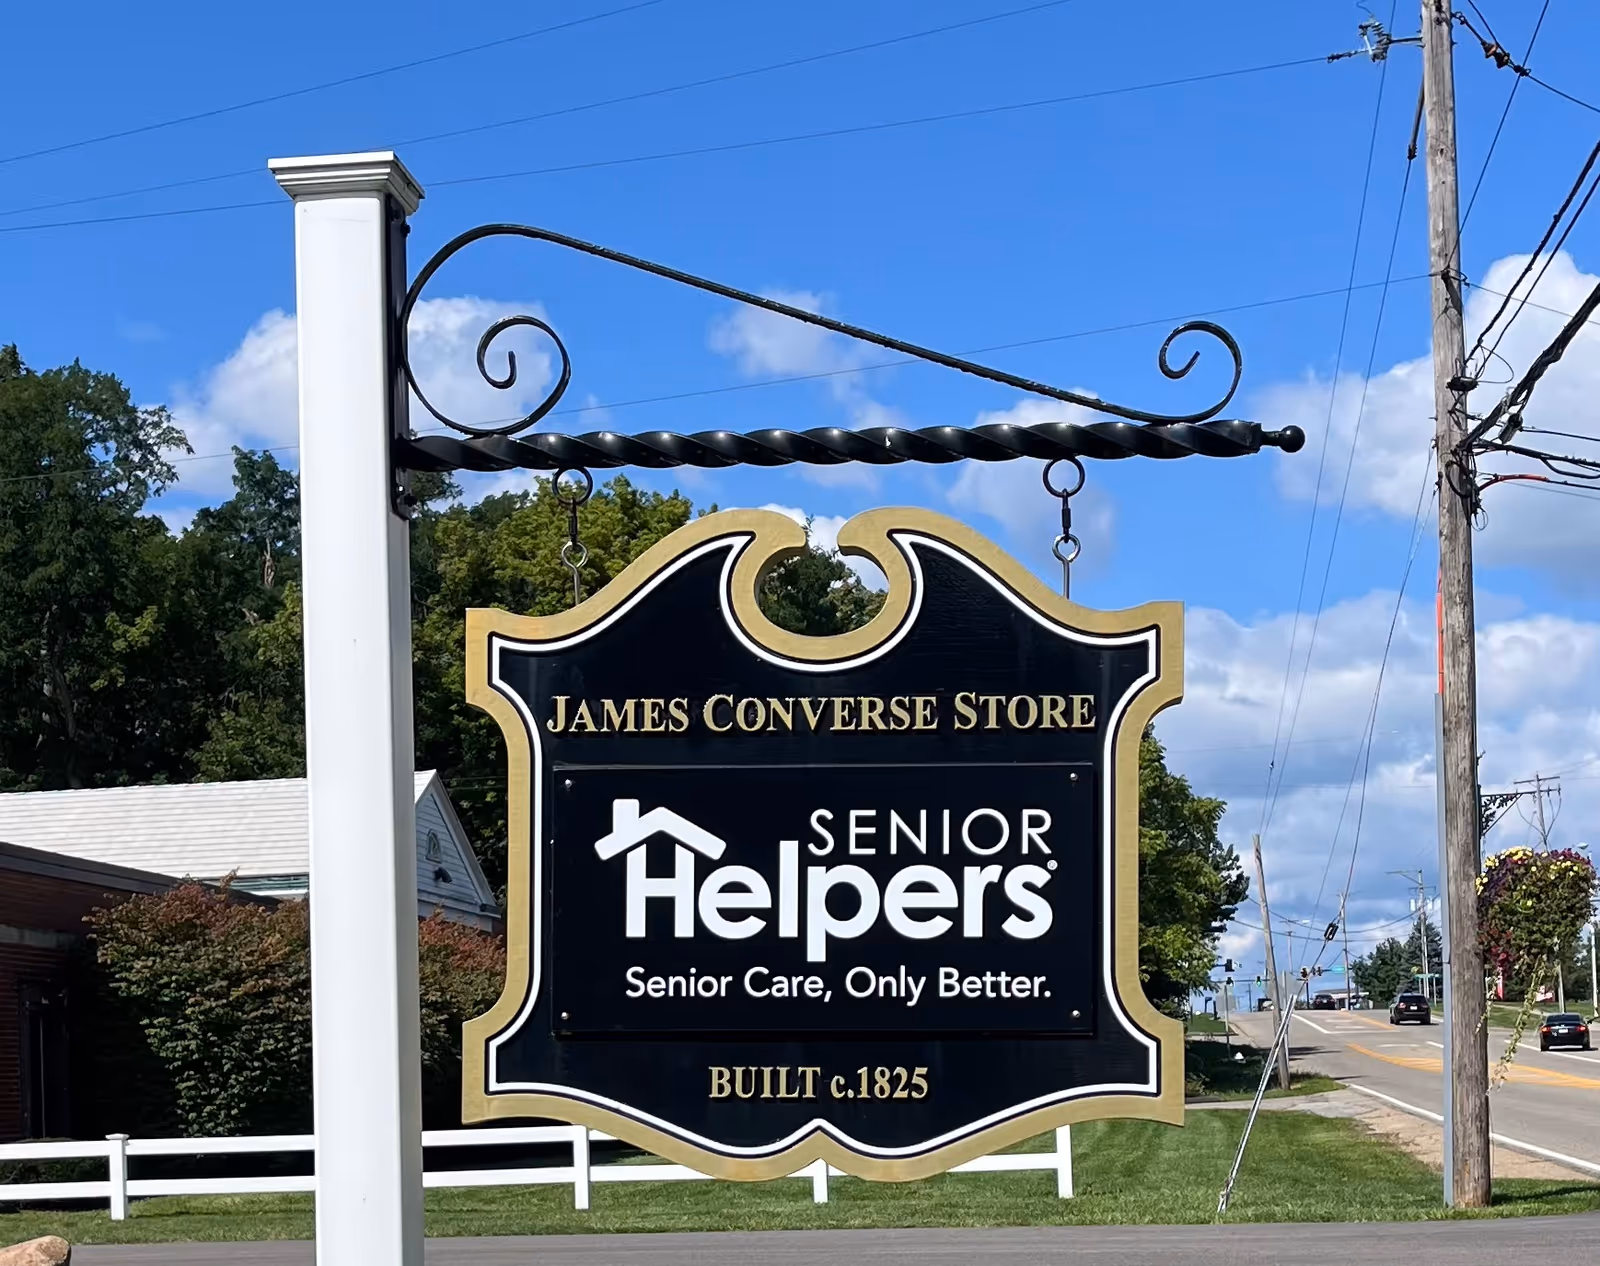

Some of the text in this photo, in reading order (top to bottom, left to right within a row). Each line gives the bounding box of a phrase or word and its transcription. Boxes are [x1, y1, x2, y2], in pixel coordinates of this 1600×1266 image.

[546, 691, 1097, 734] JAMES CONVERSE STORE
[807, 807, 1052, 856] SENIOR
[625, 964, 1052, 1007] Senior Care, Only Better.
[708, 1066, 929, 1099] BUILT c.1825
